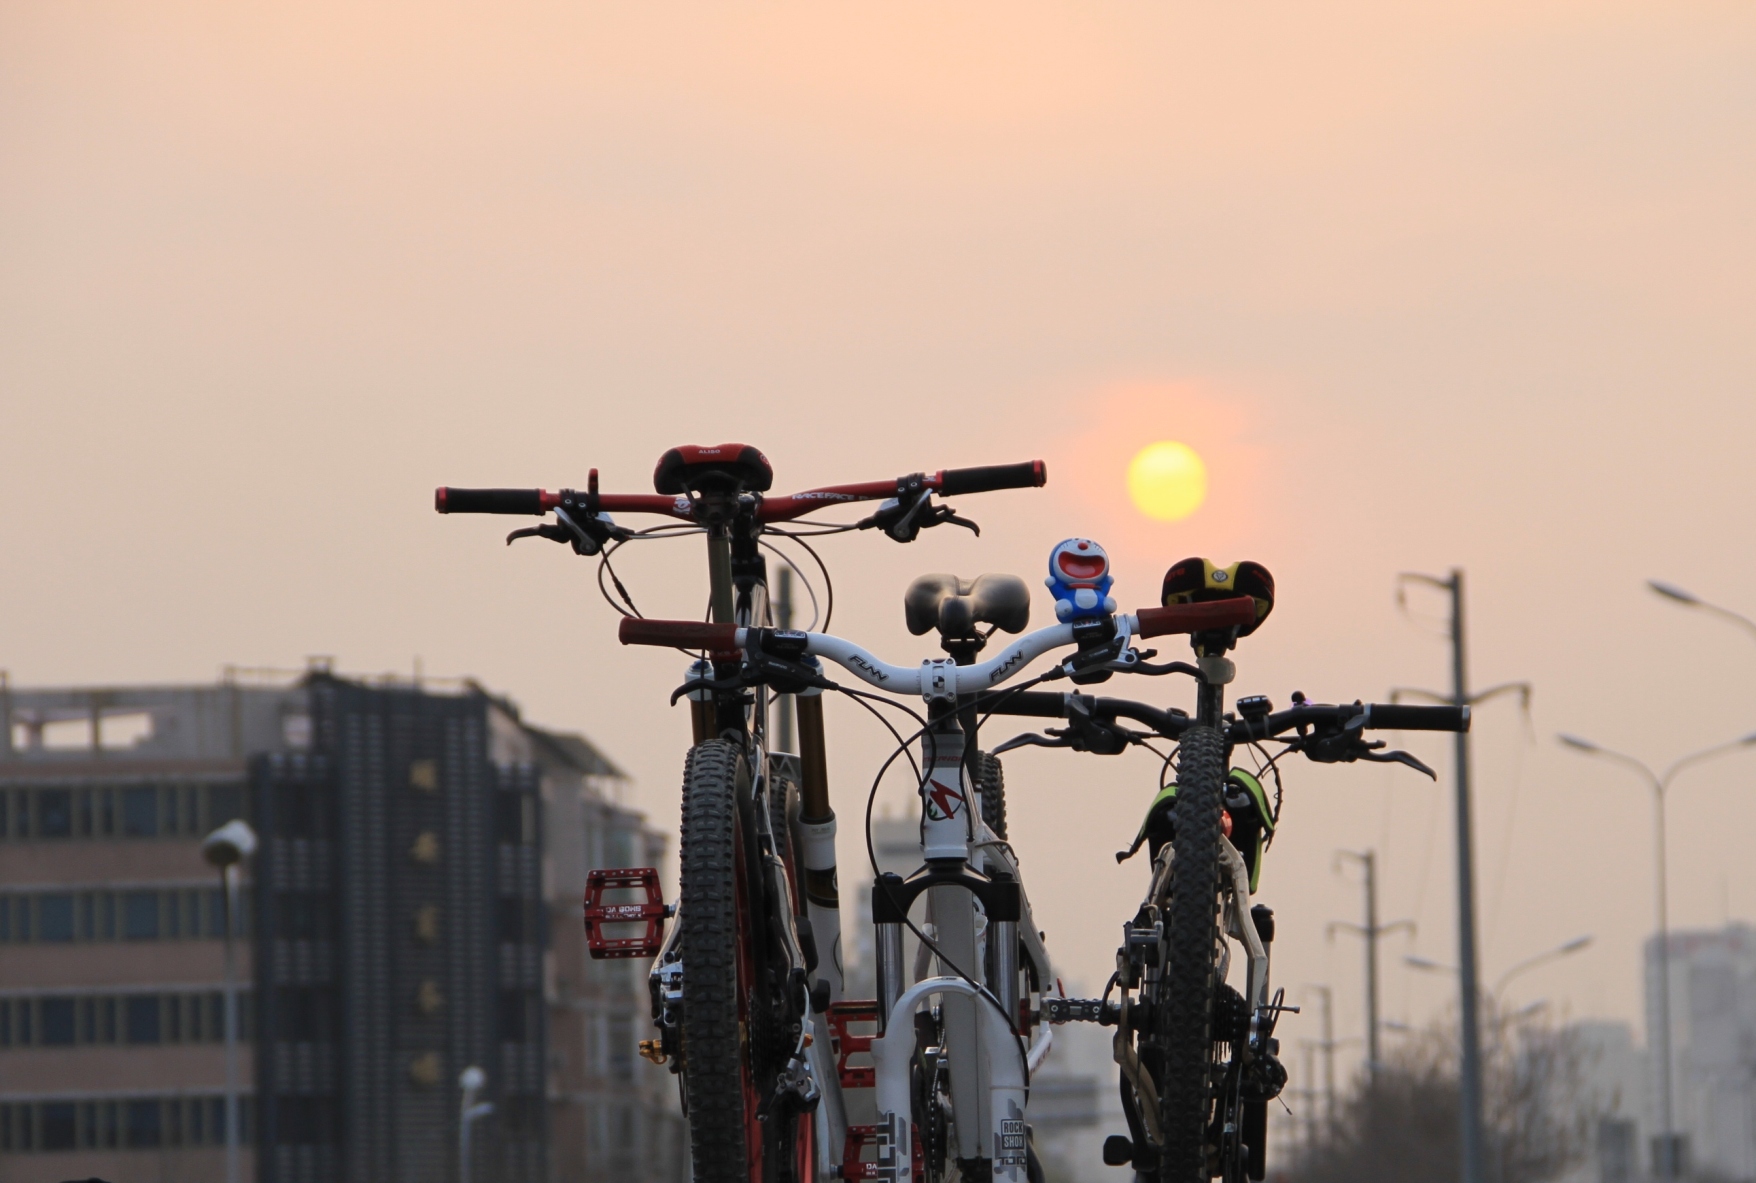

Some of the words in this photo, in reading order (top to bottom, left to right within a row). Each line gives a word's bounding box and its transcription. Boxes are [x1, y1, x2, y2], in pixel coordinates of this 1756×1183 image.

[847, 653, 889, 681] FUNN
[989, 648, 1023, 682] FUNN
[1003, 1121, 1023, 1134] ROCK
